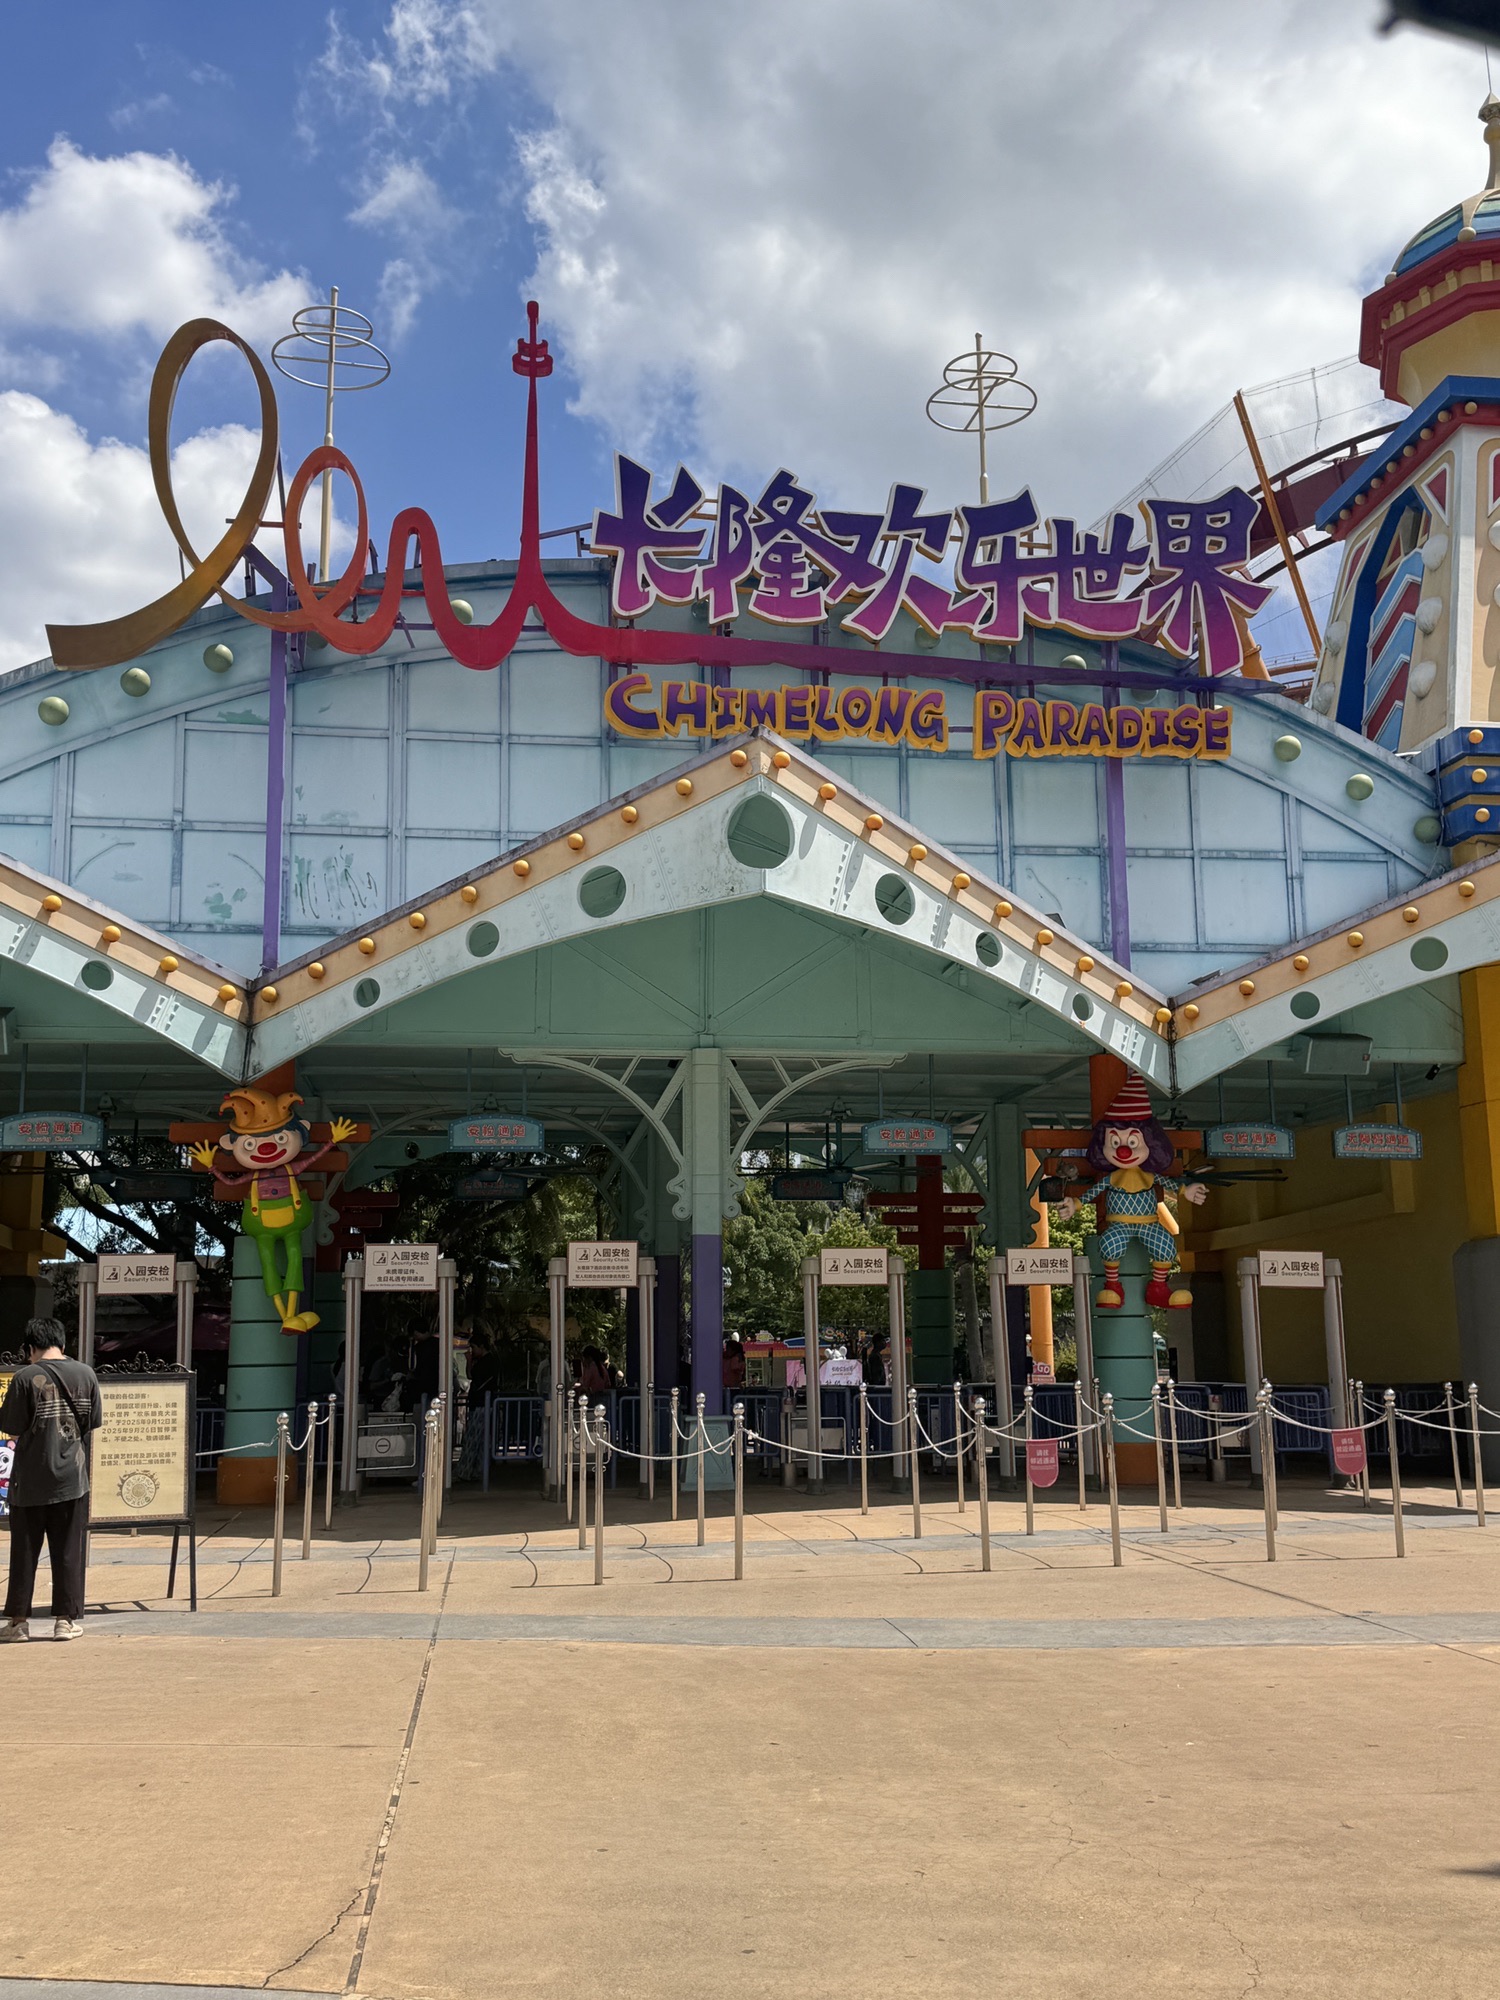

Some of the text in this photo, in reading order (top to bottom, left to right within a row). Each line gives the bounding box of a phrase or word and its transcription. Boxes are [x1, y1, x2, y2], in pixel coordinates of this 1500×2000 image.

[594, 450, 1277, 676] 长隆欢乐世界
[604, 673, 1232, 760] CHIMELONG PARADISE
[391, 1252, 429, 1260] 入园安检
[593, 1248, 630, 1257] 入园安检
[843, 1258, 883, 1268] 入园安检
[1030, 1258, 1069, 1268] 入园安检
[1281, 1261, 1320, 1271] 入园安检
[124, 1265, 169, 1276] 入园安检
